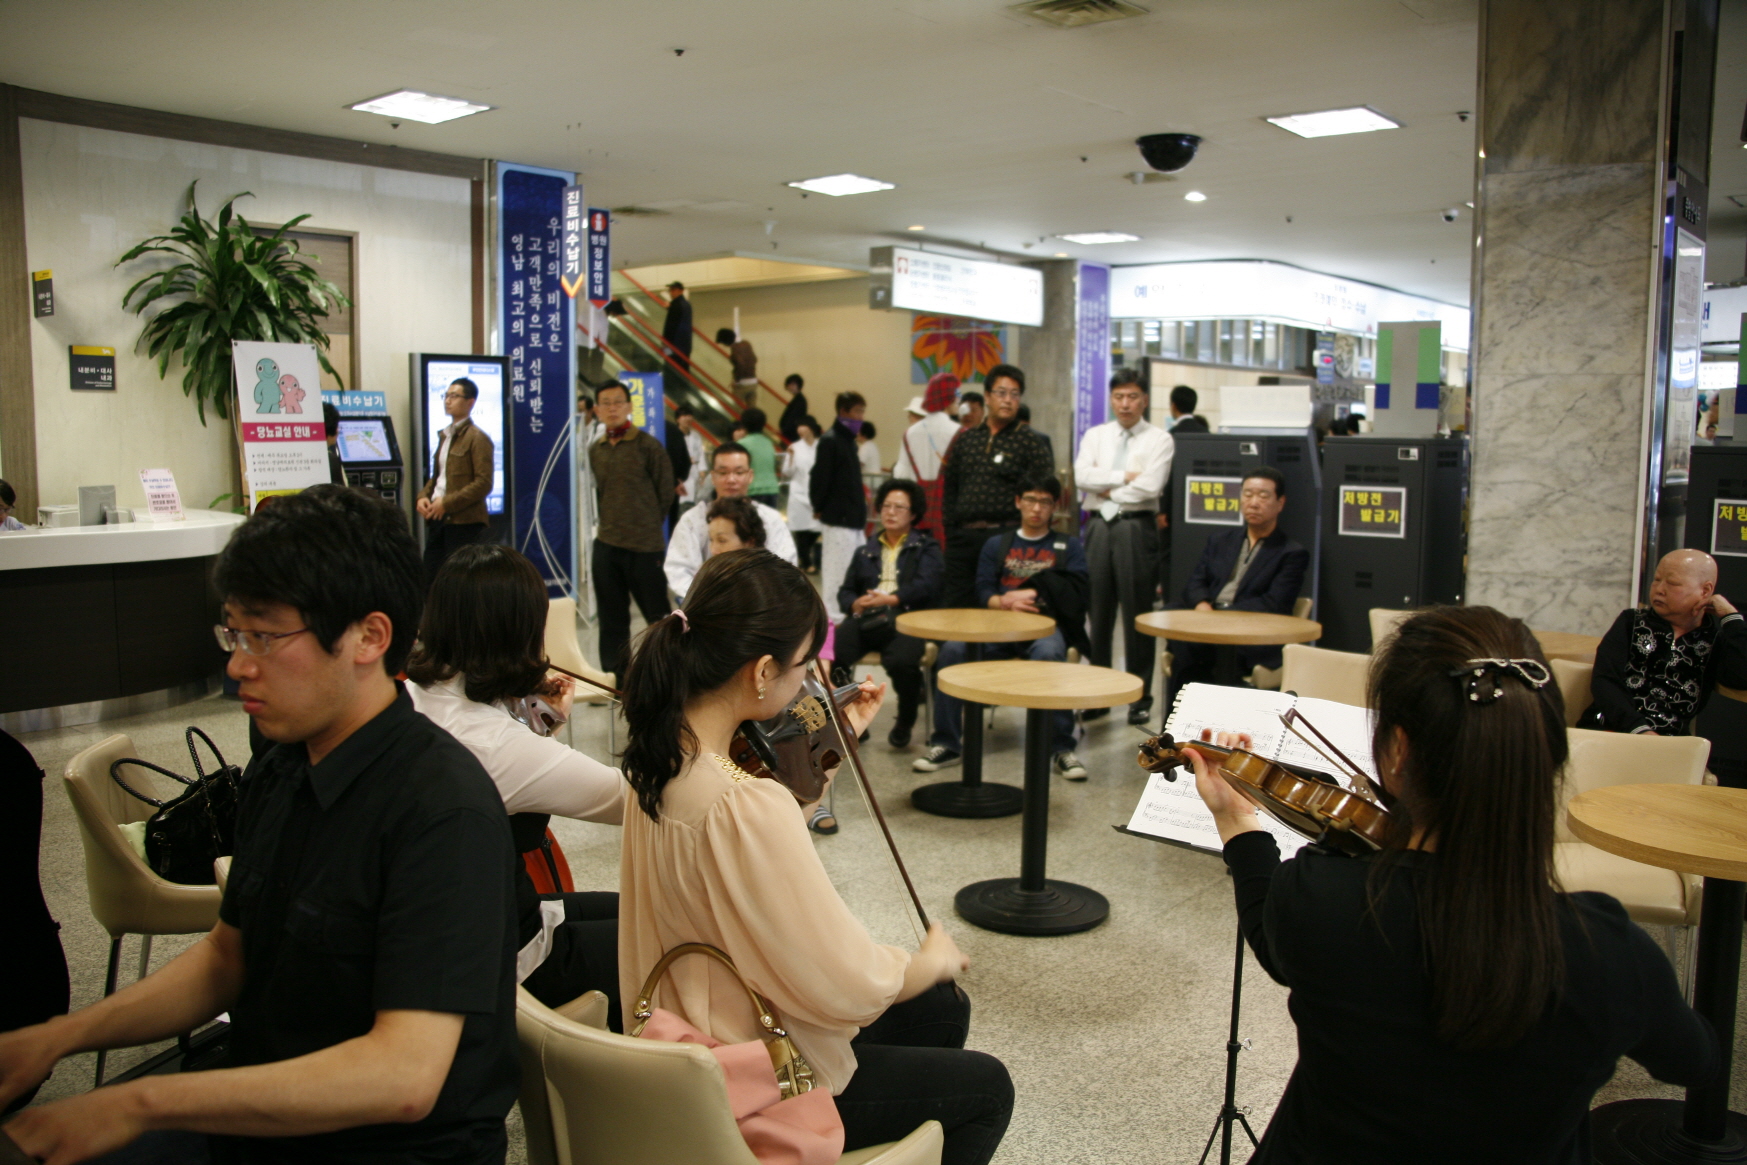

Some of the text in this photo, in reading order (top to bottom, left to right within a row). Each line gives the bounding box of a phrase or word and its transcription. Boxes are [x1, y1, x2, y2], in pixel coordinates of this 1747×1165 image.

[566, 190, 580, 274] 진료비수납기
[591, 234, 607, 247] 병원
[593, 248, 604, 296] 정보안내
[547, 217, 562, 352] 우리의 비전은
[511, 233, 526, 403] 영남 최고의 의료원
[529, 237, 543, 433] 고객만족으로 신뢰받는
[256, 425, 311, 439] 당뇨교실 안내
[1190, 482, 1224, 495] 처방전
[1204, 498, 1240, 512] 발급기
[1343, 491, 1382, 505] 처방전
[1360, 509, 1400, 523] 발급기
